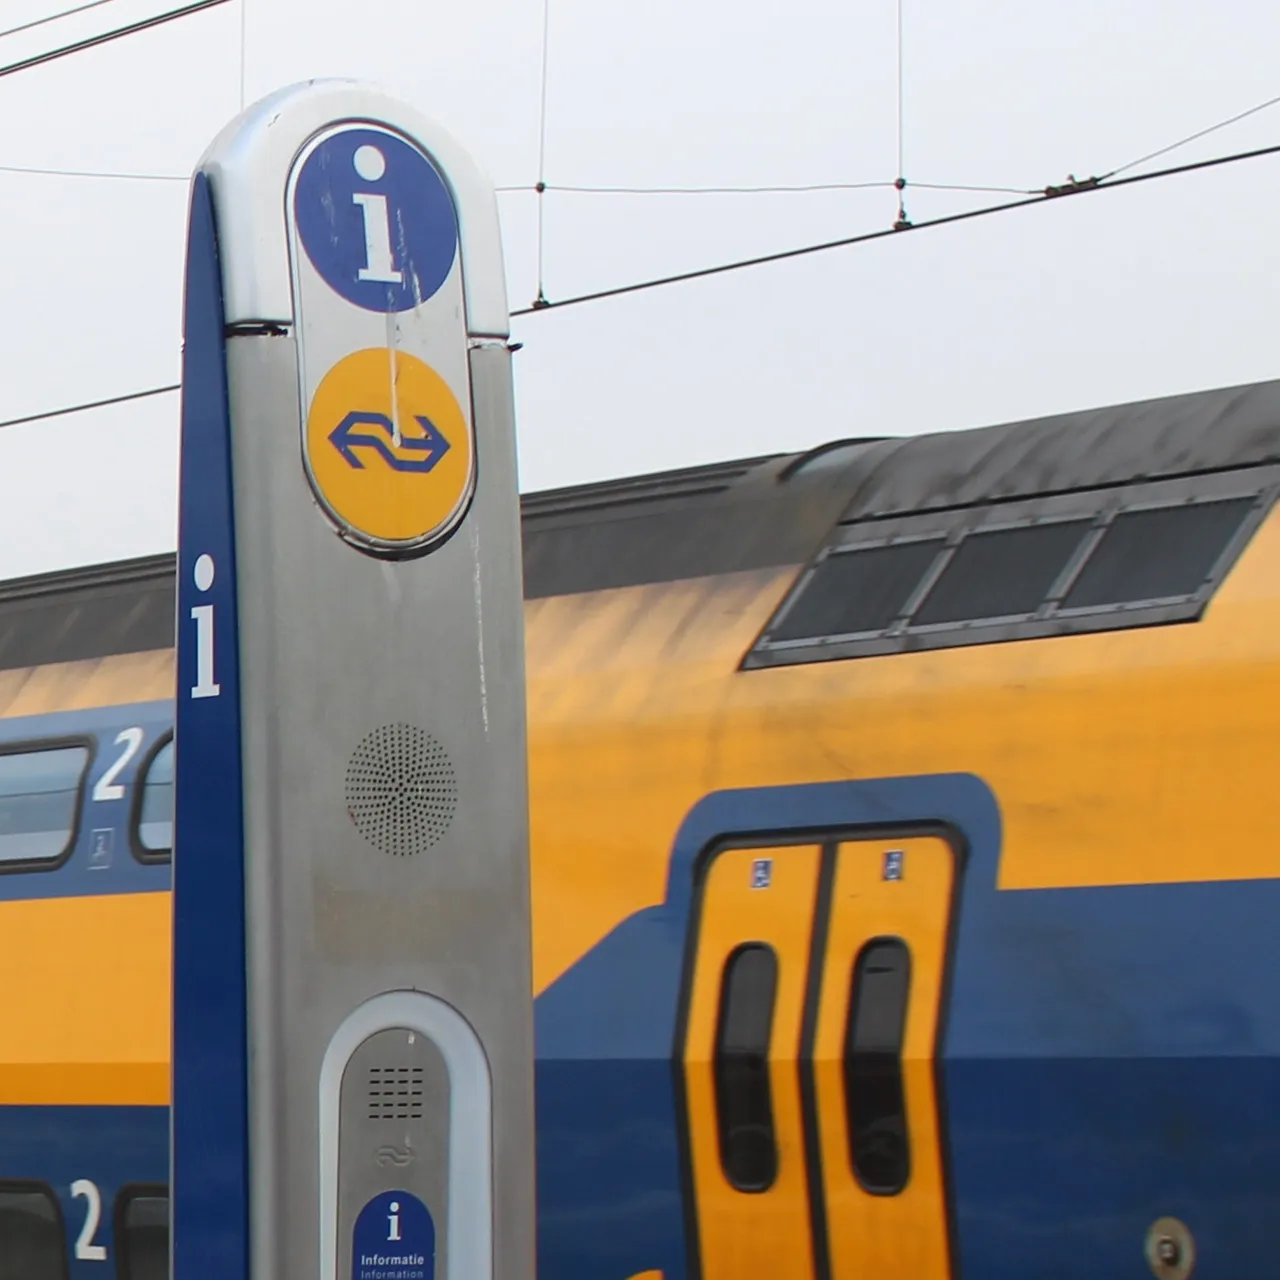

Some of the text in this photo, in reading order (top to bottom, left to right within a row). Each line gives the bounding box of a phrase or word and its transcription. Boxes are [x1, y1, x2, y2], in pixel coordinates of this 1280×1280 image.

[91, 725, 145, 802] 2
[69, 1178, 108, 1261] 2
[360, 1253, 425, 1266] Informatie
[360, 1269, 425, 1280] Information
